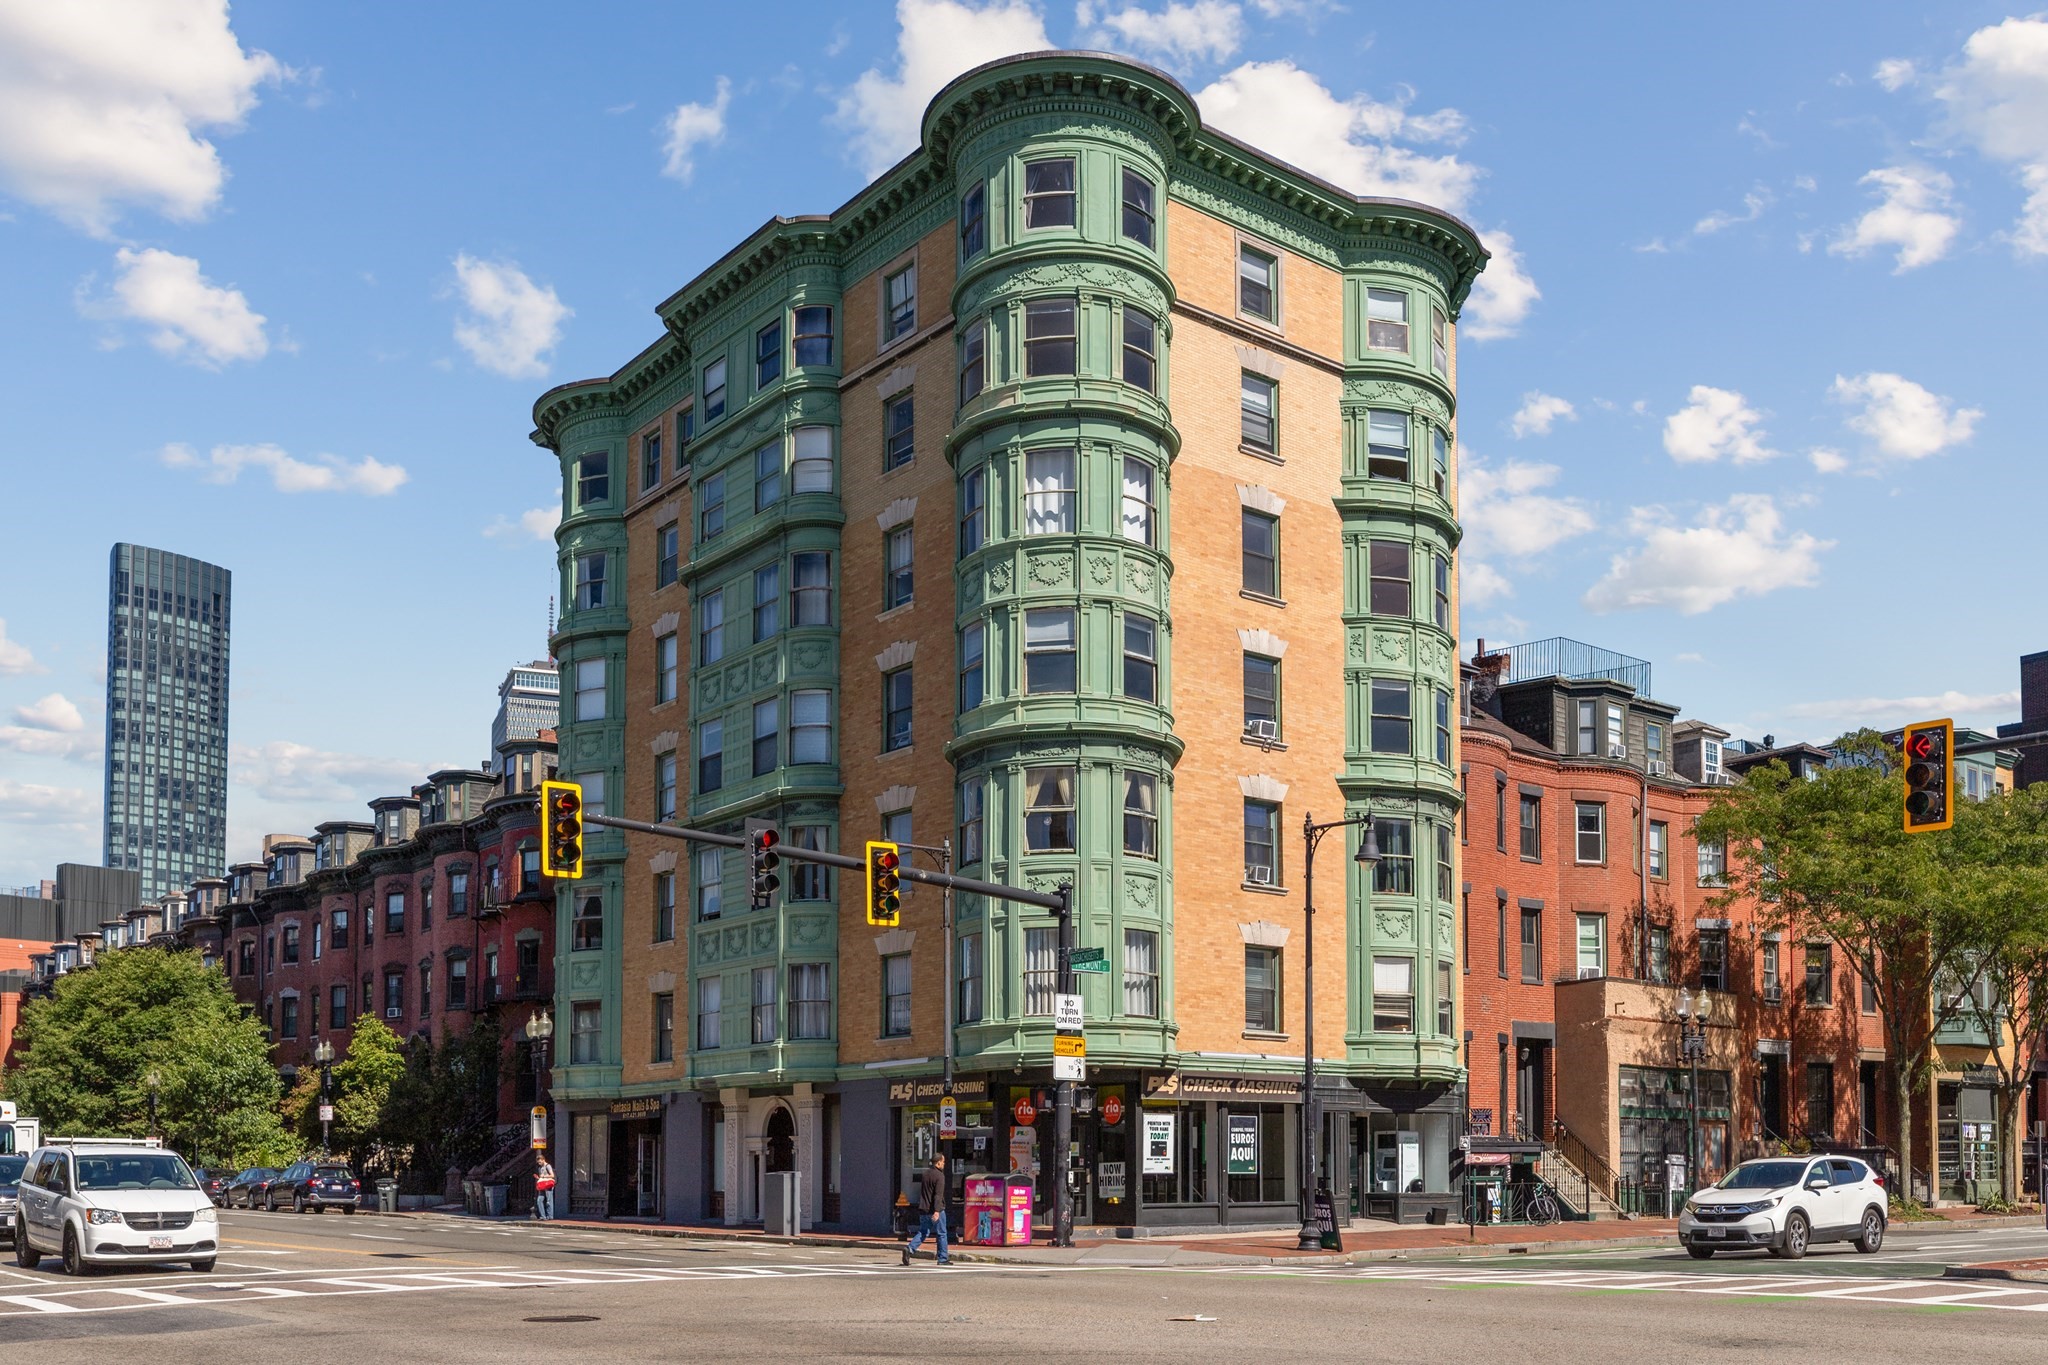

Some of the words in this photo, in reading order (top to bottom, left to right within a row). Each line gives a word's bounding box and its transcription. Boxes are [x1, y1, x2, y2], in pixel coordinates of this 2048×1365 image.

[1061, 1008, 1078, 1016] TURN
[1057, 1016, 1067, 1024] ON
[1068, 1016, 1081, 1024] RED
[917, 1083, 944, 1097] CHECK
[951, 1081, 985, 1094] ASHING
[1183, 1078, 1234, 1093] CHECK
[1236, 1080, 1298, 1095] CASHING
[1018, 1101, 1033, 1115] ria
[1105, 1100, 1119, 1113] ria
[1231, 1133, 1255, 1144] EUROS
[1230, 1144, 1254, 1161] AQUÍ
[1103, 1163, 1122, 1175] NOW
[1099, 1175, 1126, 1187] HIRING
[1317, 1218, 1333, 1232] QUÍ
